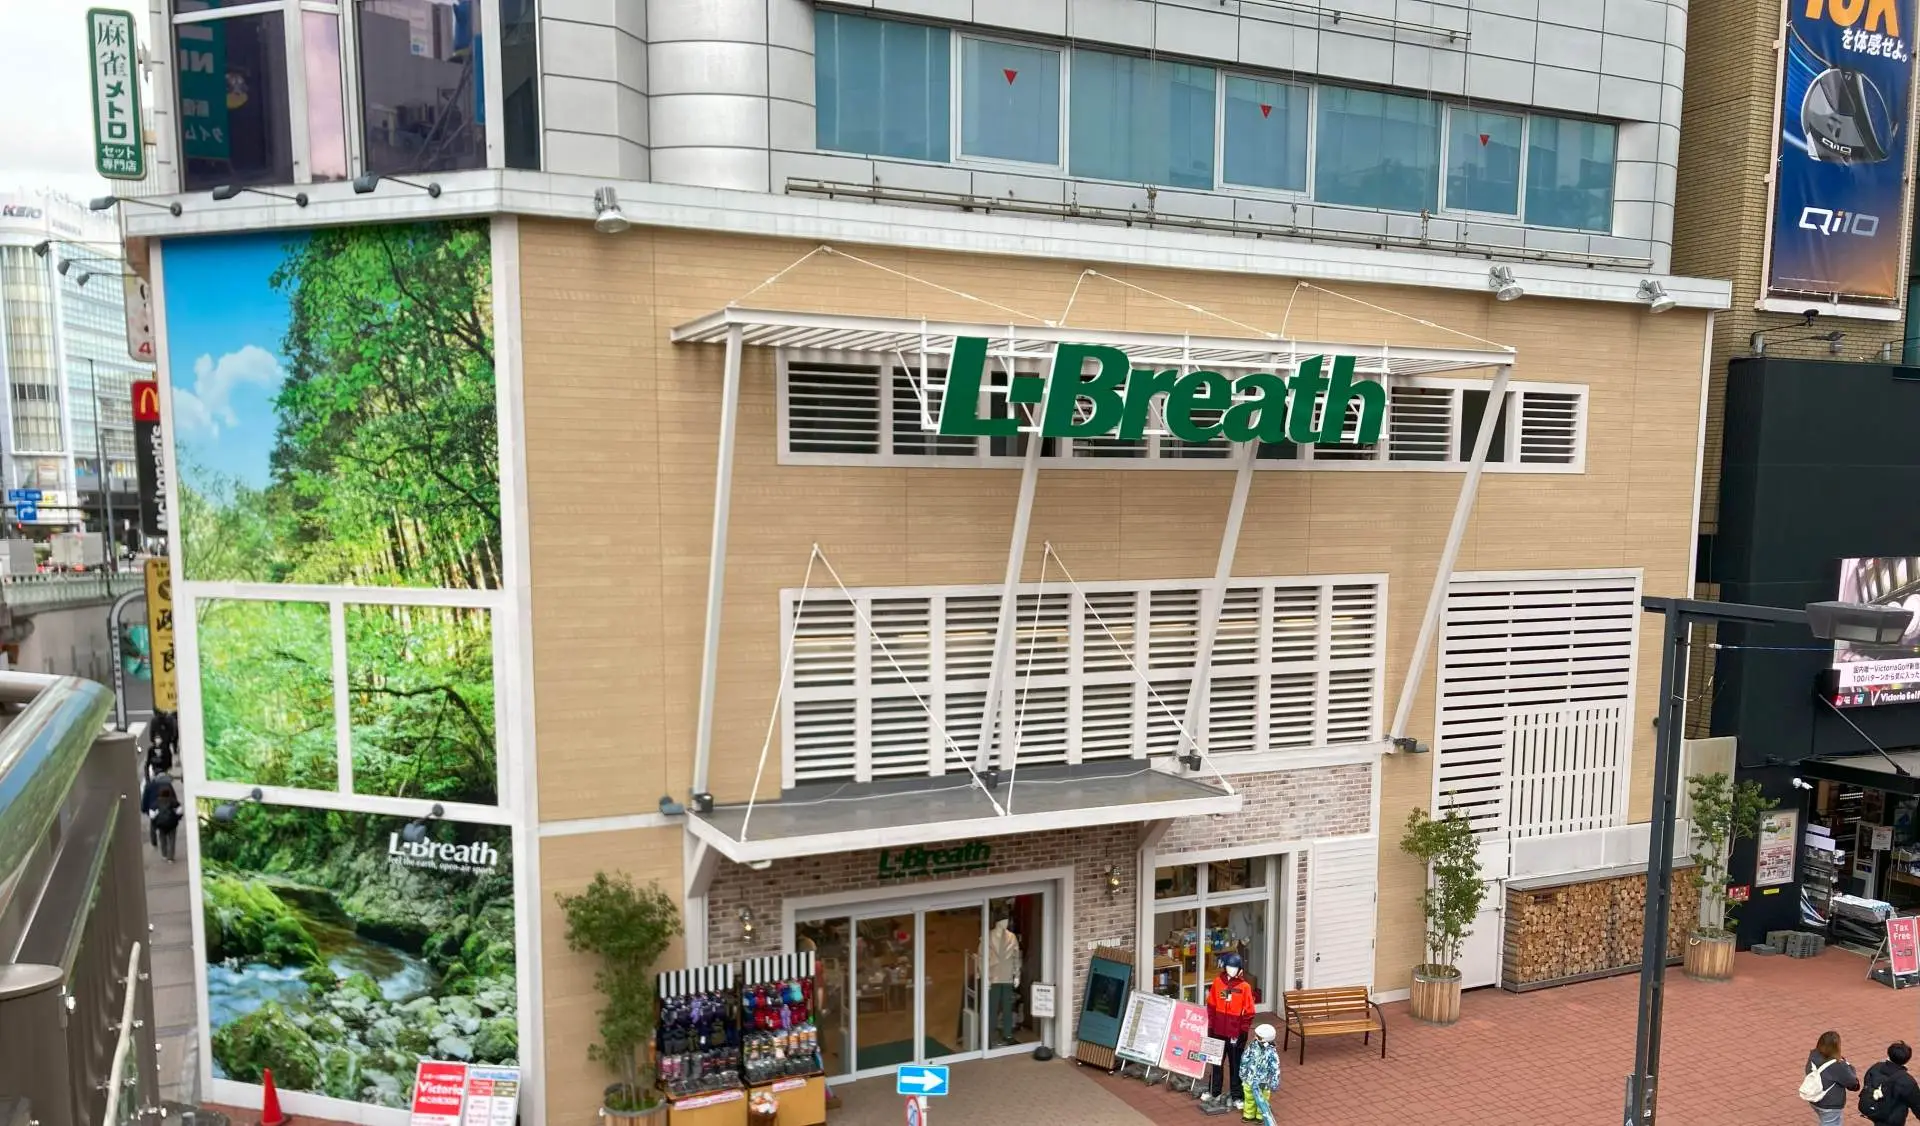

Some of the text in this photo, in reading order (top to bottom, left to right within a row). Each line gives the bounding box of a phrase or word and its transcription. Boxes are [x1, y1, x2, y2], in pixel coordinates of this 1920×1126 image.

[1841, 27, 1907, 62] を体感せよ。
[97, 20, 128, 138] 麻雀メトロ
[102, 146, 136, 158] セット
[103, 159, 137, 172] 専門店
[3, 204, 42, 218] KEIO
[1799, 207, 1879, 236] Qi10
[938, 336, 1386, 444] L-Breath
[1881, 691, 1906, 702] Victoria
[388, 832, 498, 867] L-Breath
[1893, 923, 1909, 932] Tax
[1893, 933, 1911, 941] Free
[1185, 1008, 1205, 1021] Tax
[419, 1081, 465, 1096] Victoria
